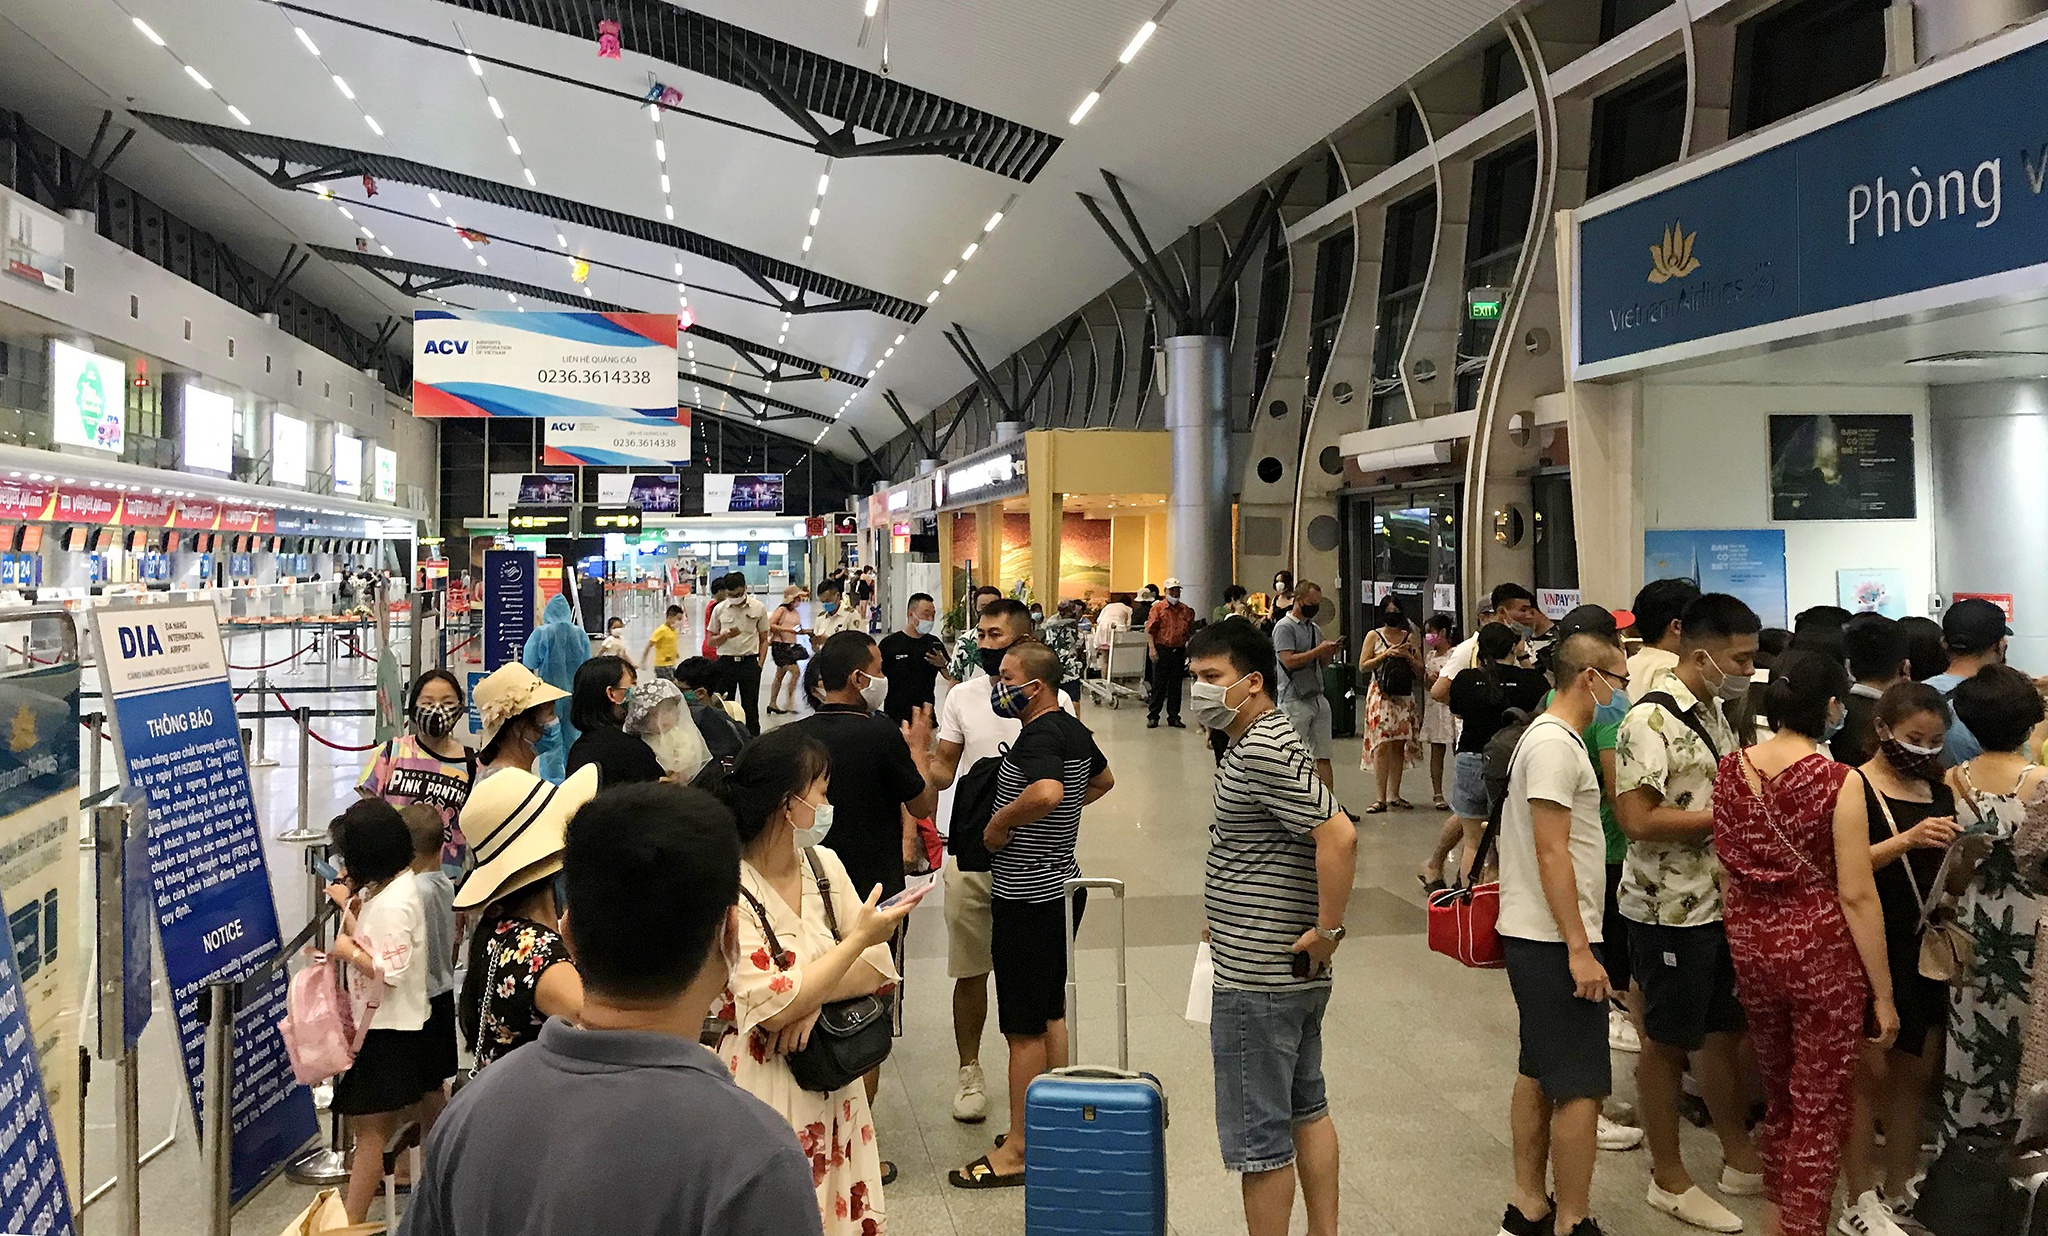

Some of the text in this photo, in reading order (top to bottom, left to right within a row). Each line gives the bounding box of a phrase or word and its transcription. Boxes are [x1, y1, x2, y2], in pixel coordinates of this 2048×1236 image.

[1849, 158, 2001, 245] Phòng
[1473, 306, 1492, 316] EXIT
[1610, 279, 1744, 332] Vietnam Airlines
[424, 340, 469, 355] ACV
[538, 369, 651, 384] 0236.3614338
[551, 423, 576, 431] ACV
[613, 439, 676, 448] 0236.3614338
[4, 561, 14, 578] 23
[21, 561, 31, 578] 24
[1544, 594, 1569, 606] VNPAY
[118, 625, 164, 660] DIA
[147, 706, 213, 738] THÔNG BÁO
[170, 751, 182, 762] cao
[238, 780, 246, 791] T1
[389, 770, 423, 794] PINK
[203, 919, 244, 954] NOTICE
[175, 988, 187, 1001] For
[187, 982, 198, 994] the
[21, 1053, 33, 1079] T1
